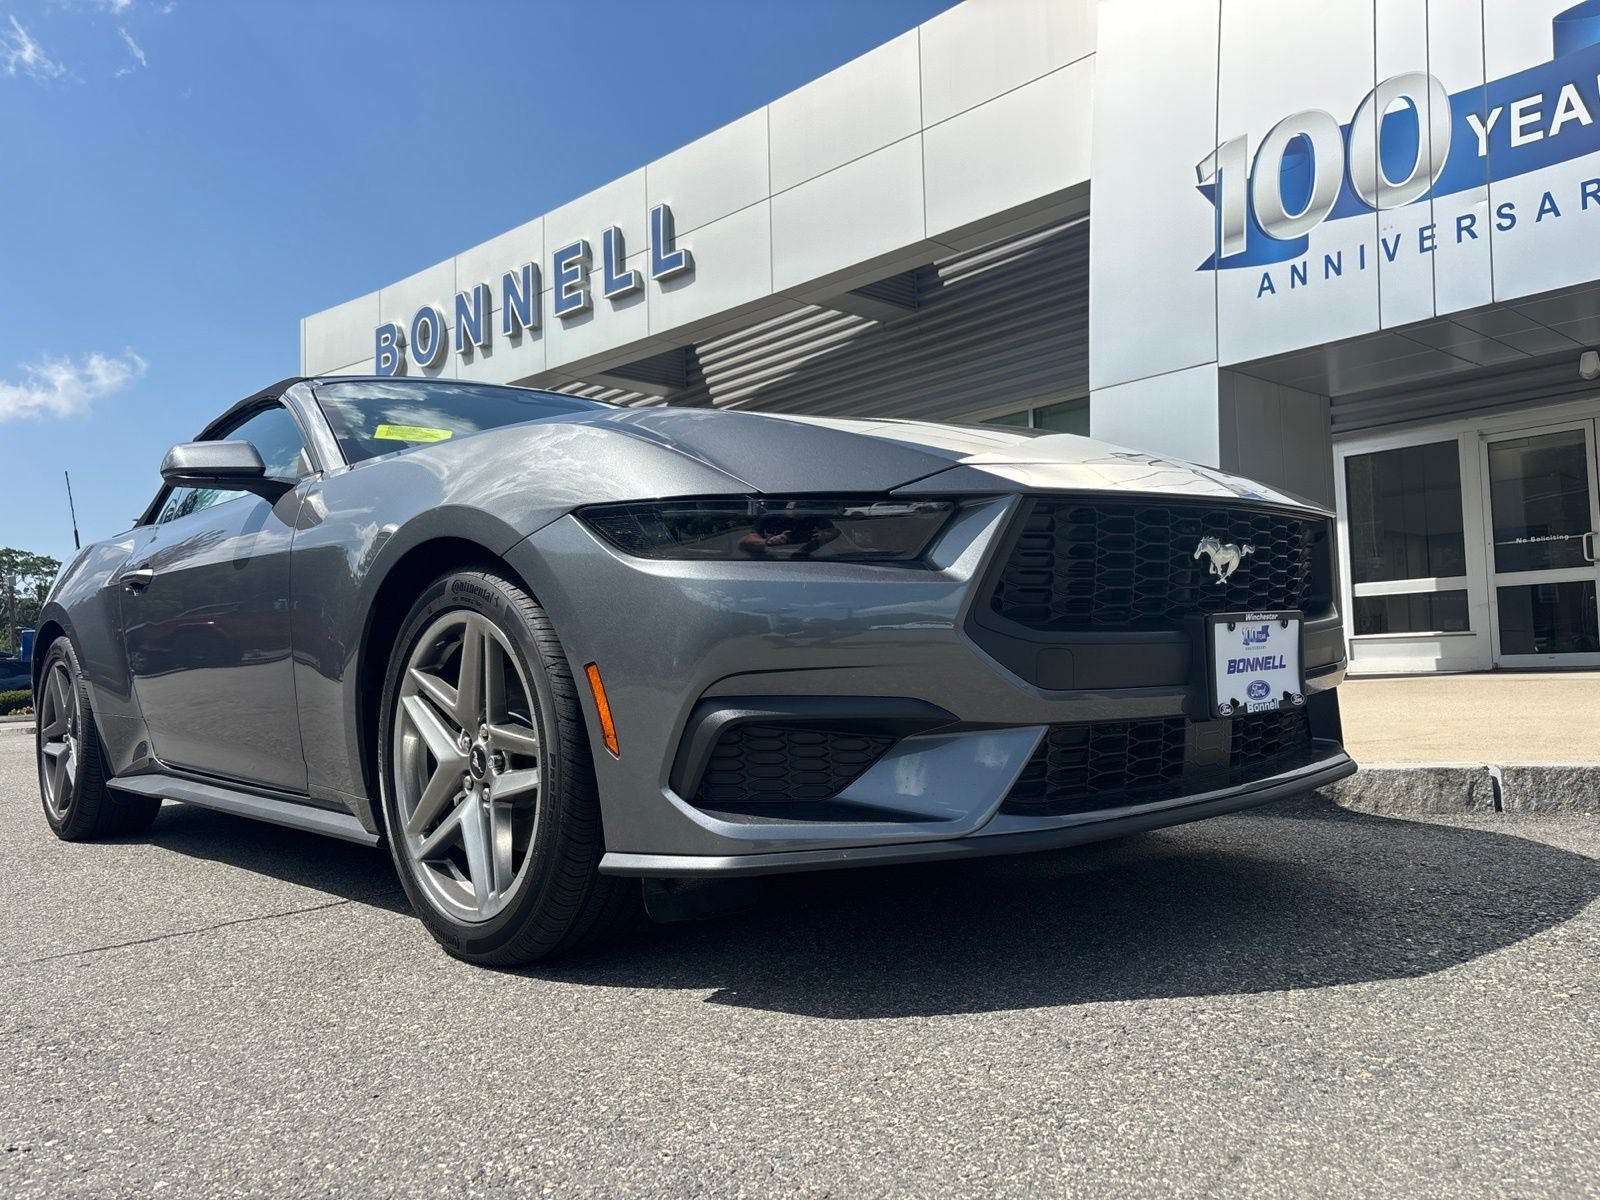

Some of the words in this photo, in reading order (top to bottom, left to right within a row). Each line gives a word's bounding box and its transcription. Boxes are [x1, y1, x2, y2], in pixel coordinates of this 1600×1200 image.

[1196, 71, 1452, 259] 100
[1466, 74, 1600, 157] YEA
[375, 203, 690, 377] BONNELL
[1530, 534, 1569, 543] Soliciting
[451, 578, 495, 604] Continental
[1245, 613, 1278, 621] Winchester
[1227, 655, 1286, 674] BONNELL
[1246, 699, 1280, 713] Bonnell
